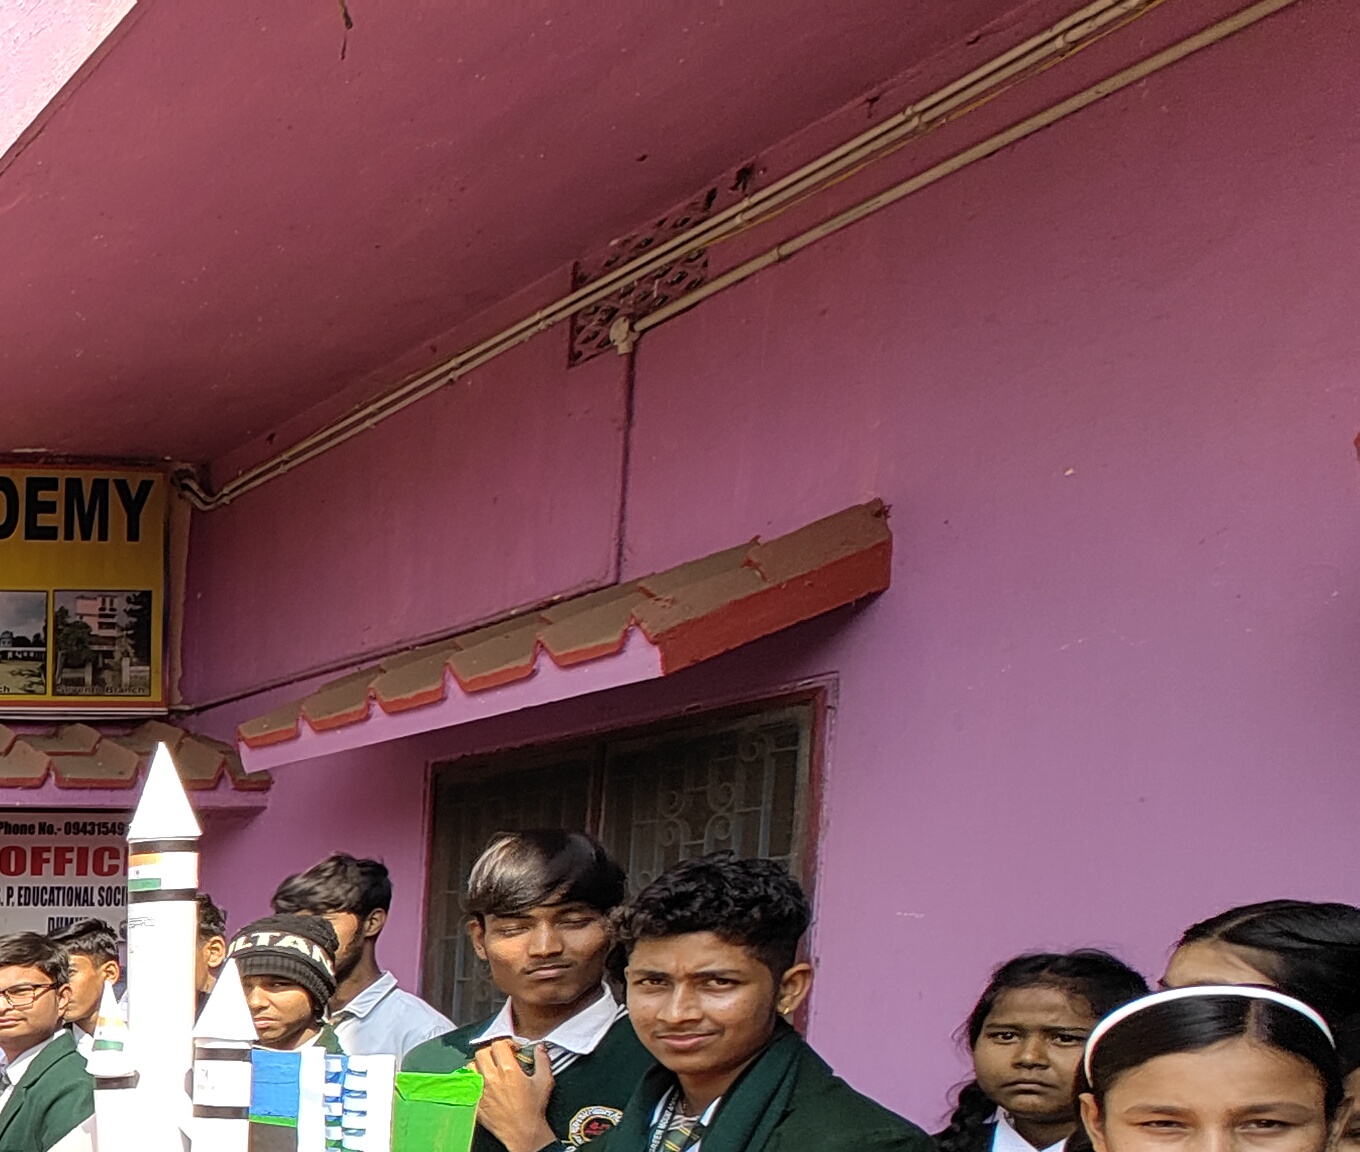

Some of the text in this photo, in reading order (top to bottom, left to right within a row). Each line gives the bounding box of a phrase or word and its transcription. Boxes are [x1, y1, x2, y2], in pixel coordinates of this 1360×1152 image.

[105, 685, 145, 694] Branch
[63, 821, 129, 836] 09431549
[17, 886, 95, 907] EDUCATIONAL
[97, 886, 128, 907] SOCI
